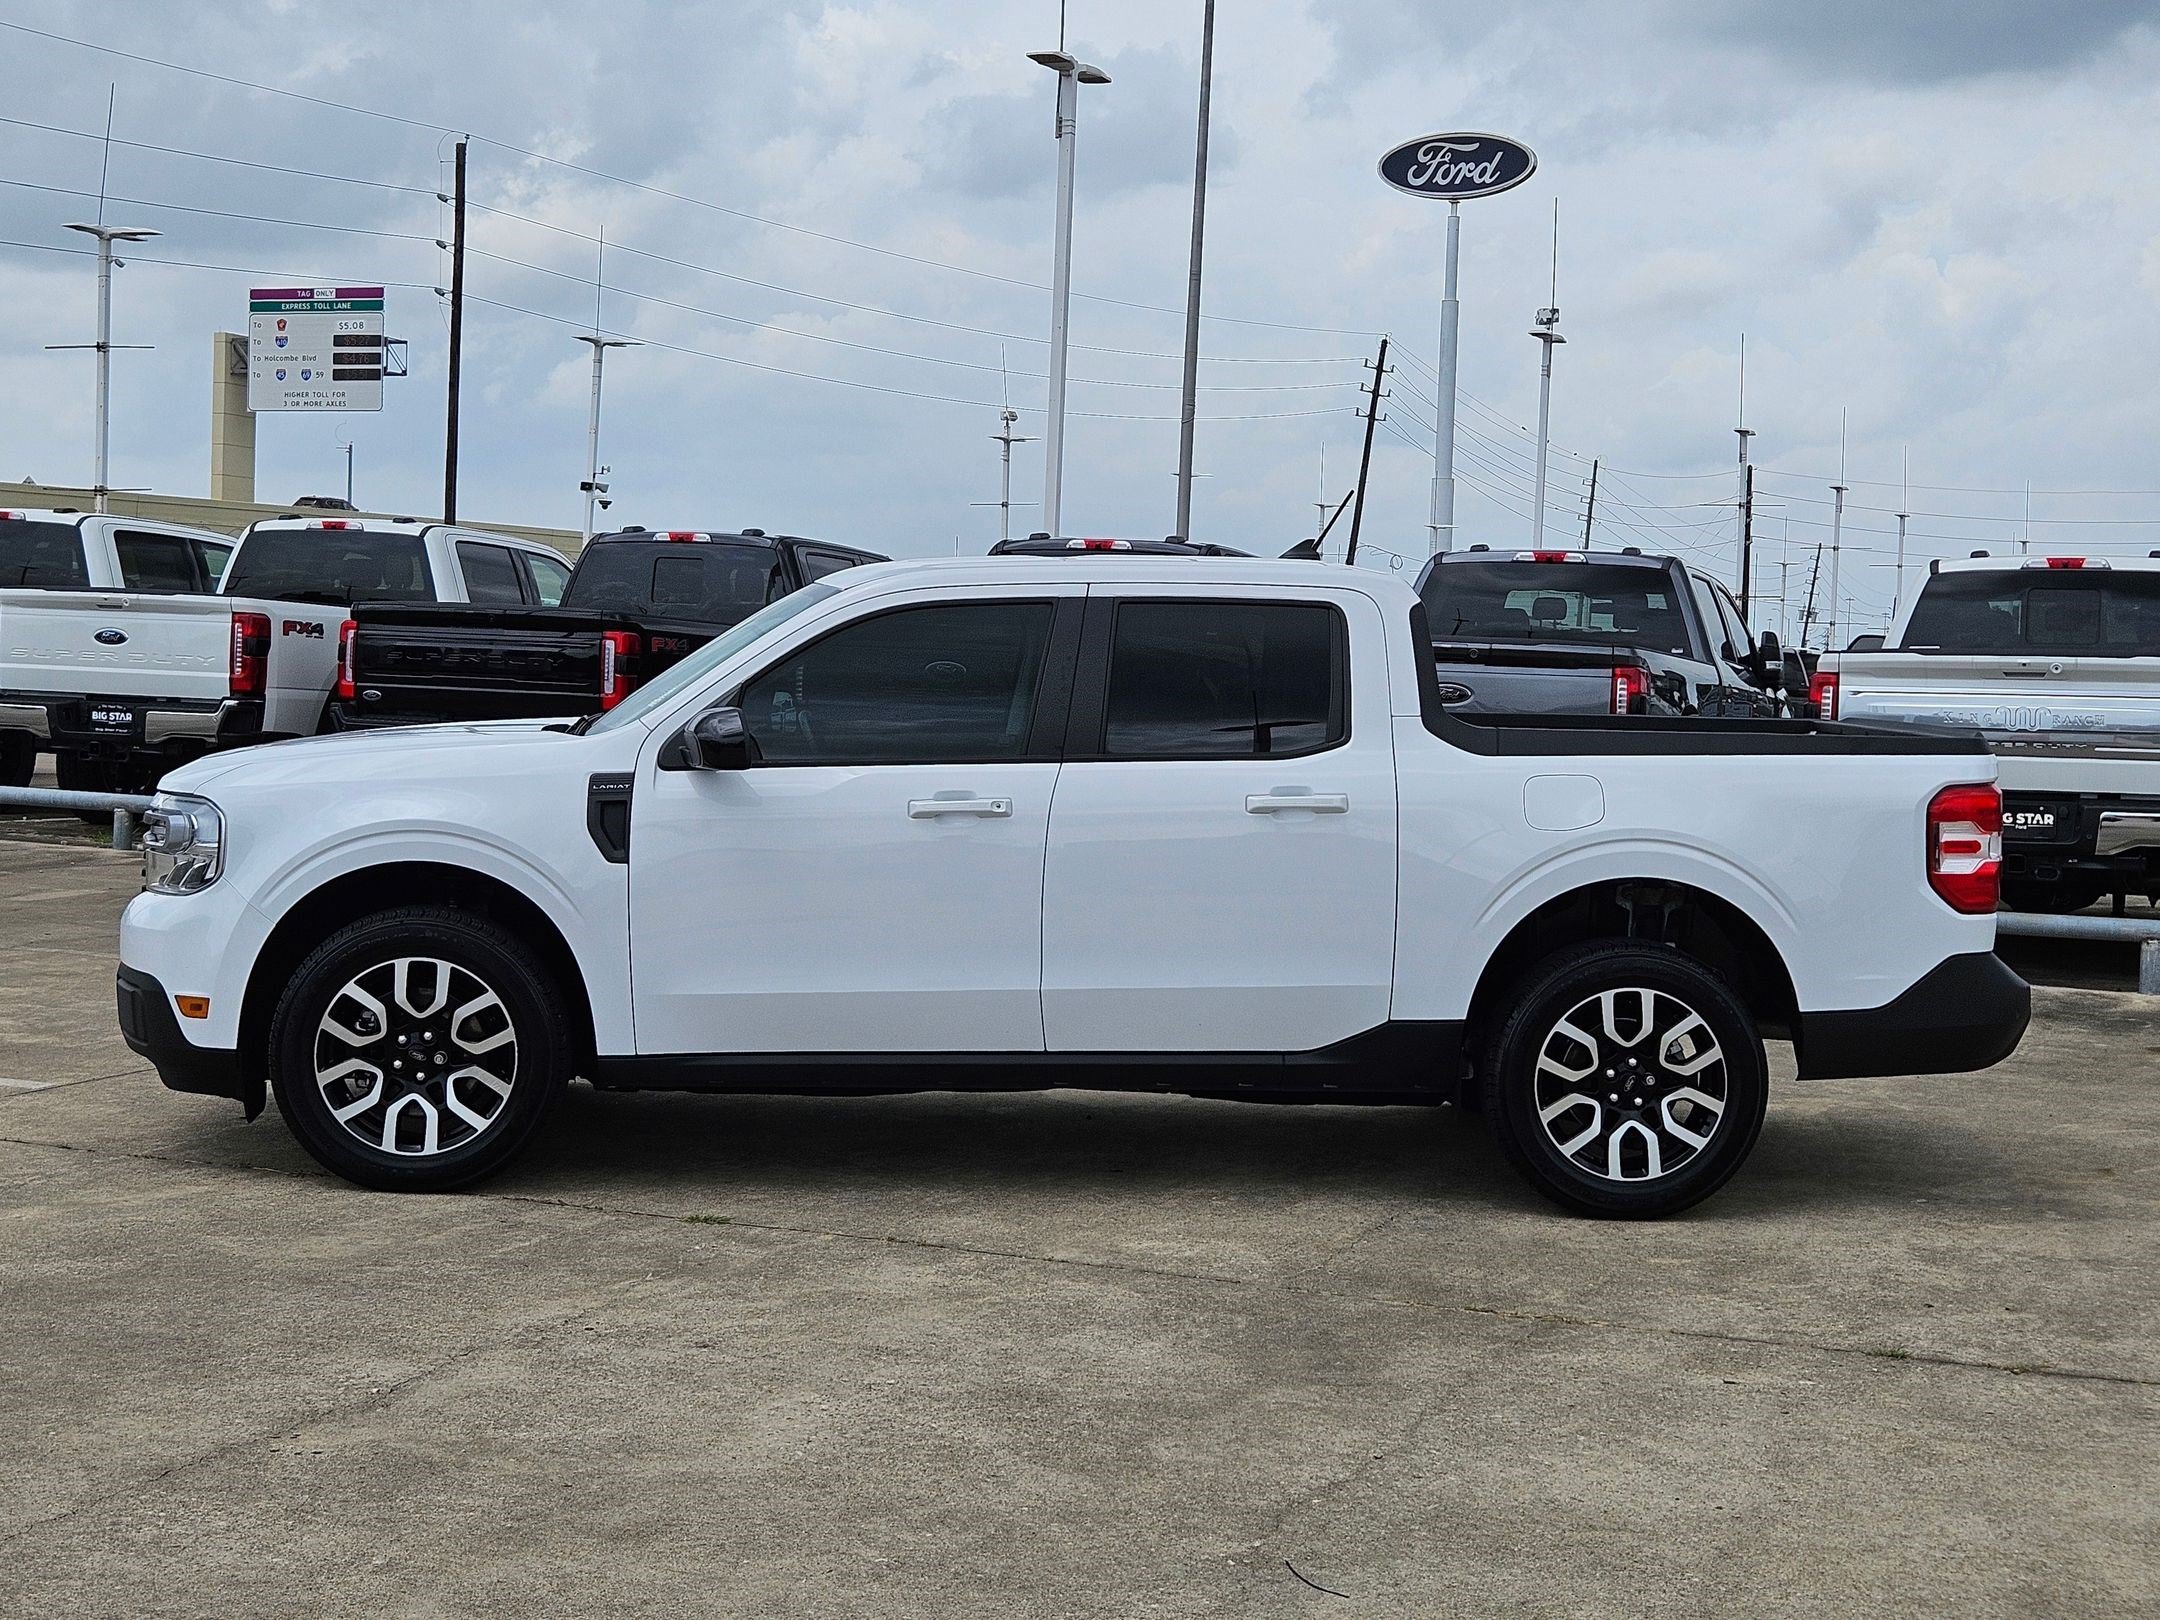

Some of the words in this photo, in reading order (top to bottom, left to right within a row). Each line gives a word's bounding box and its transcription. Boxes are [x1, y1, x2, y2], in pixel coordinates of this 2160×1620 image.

[1407, 142, 1503, 186] Ford
[281, 302, 311, 310] EXPRESS
[338, 321, 364, 330] $5.08
[253, 338, 262, 346] To
[315, 371, 325, 379] 59
[282, 620, 324, 636] FX4
[652, 637, 688, 651] FX4
[10, 647, 119, 662] SUPER
[127, 652, 215, 666] DUTY
[92, 711, 108, 720] BIG
[109, 712, 132, 721] STAR
[1943, 711, 1992, 725] KING
[2052, 714, 2105, 727] RANCH
[2016, 812, 2054, 825] STAR
